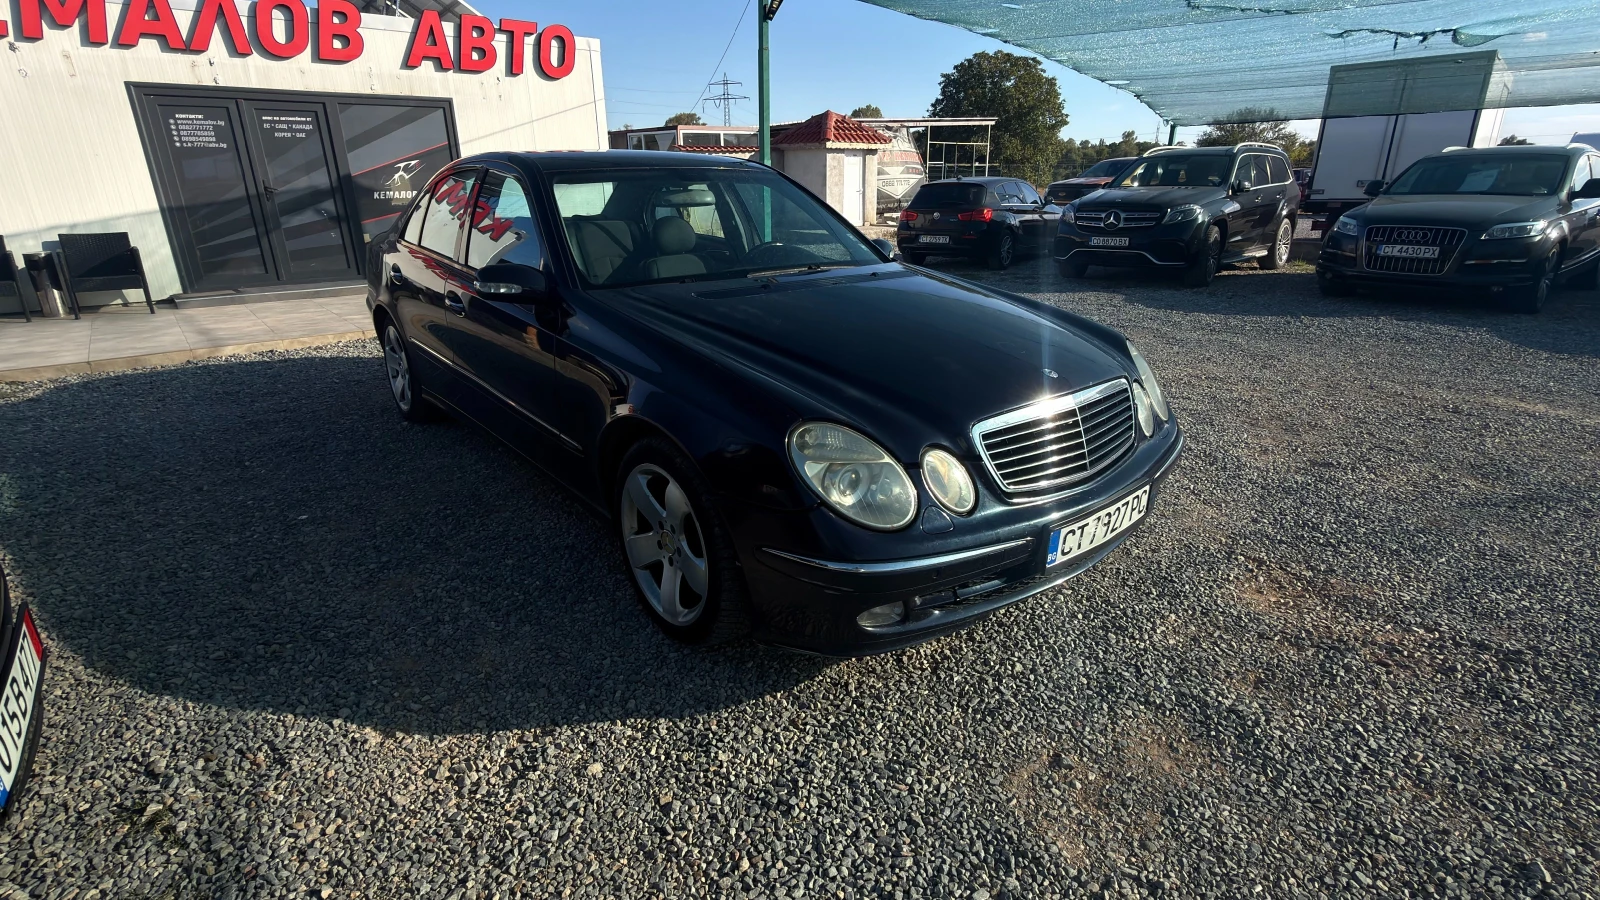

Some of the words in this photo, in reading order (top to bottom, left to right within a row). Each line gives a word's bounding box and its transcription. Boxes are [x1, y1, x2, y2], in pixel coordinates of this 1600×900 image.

[0, 0, 364, 61] МАЛОВ
[406, 10, 576, 79] АВТО
[1382, 246, 1396, 254] CT
[1397, 246, 1422, 256] 4430
[1422, 248, 1438, 257] PX
[1048, 552, 1057, 562] BG
